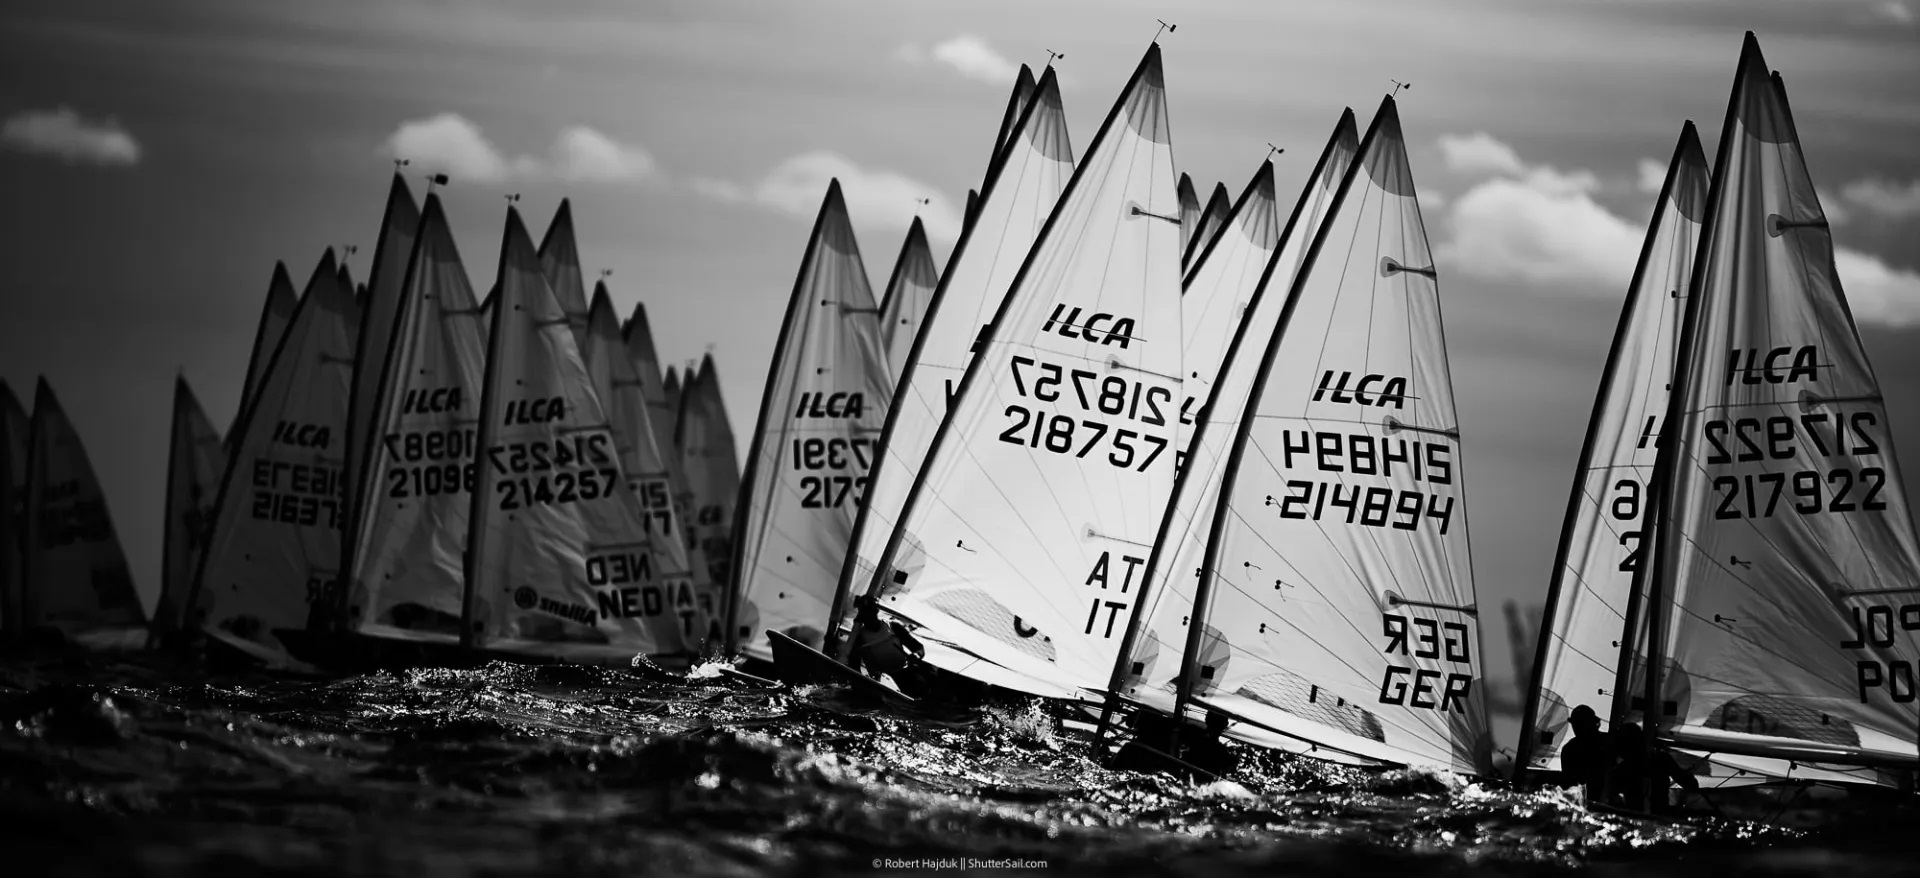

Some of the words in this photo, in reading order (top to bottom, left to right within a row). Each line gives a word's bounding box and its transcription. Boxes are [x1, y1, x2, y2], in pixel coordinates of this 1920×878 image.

[1041, 303, 1136, 349] ILCA
[1727, 346, 1818, 386] ILCA
[404, 387, 461, 413] ILCA
[796, 392, 862, 418] ILCA
[1312, 370, 1407, 409] ILCA
[504, 397, 564, 425] ILCA
[274, 421, 330, 449] ILCA
[999, 405, 1168, 473] 218757
[389, 465, 475, 498] 21098
[497, 467, 617, 510] 214257
[1713, 467, 1887, 520] 217922
[1280, 480, 1454, 535] 214894
[598, 586, 663, 619] NED
[1085, 598, 1128, 638] IT
[1379, 665, 1472, 714] GER
[1857, 661, 1920, 704] PO
